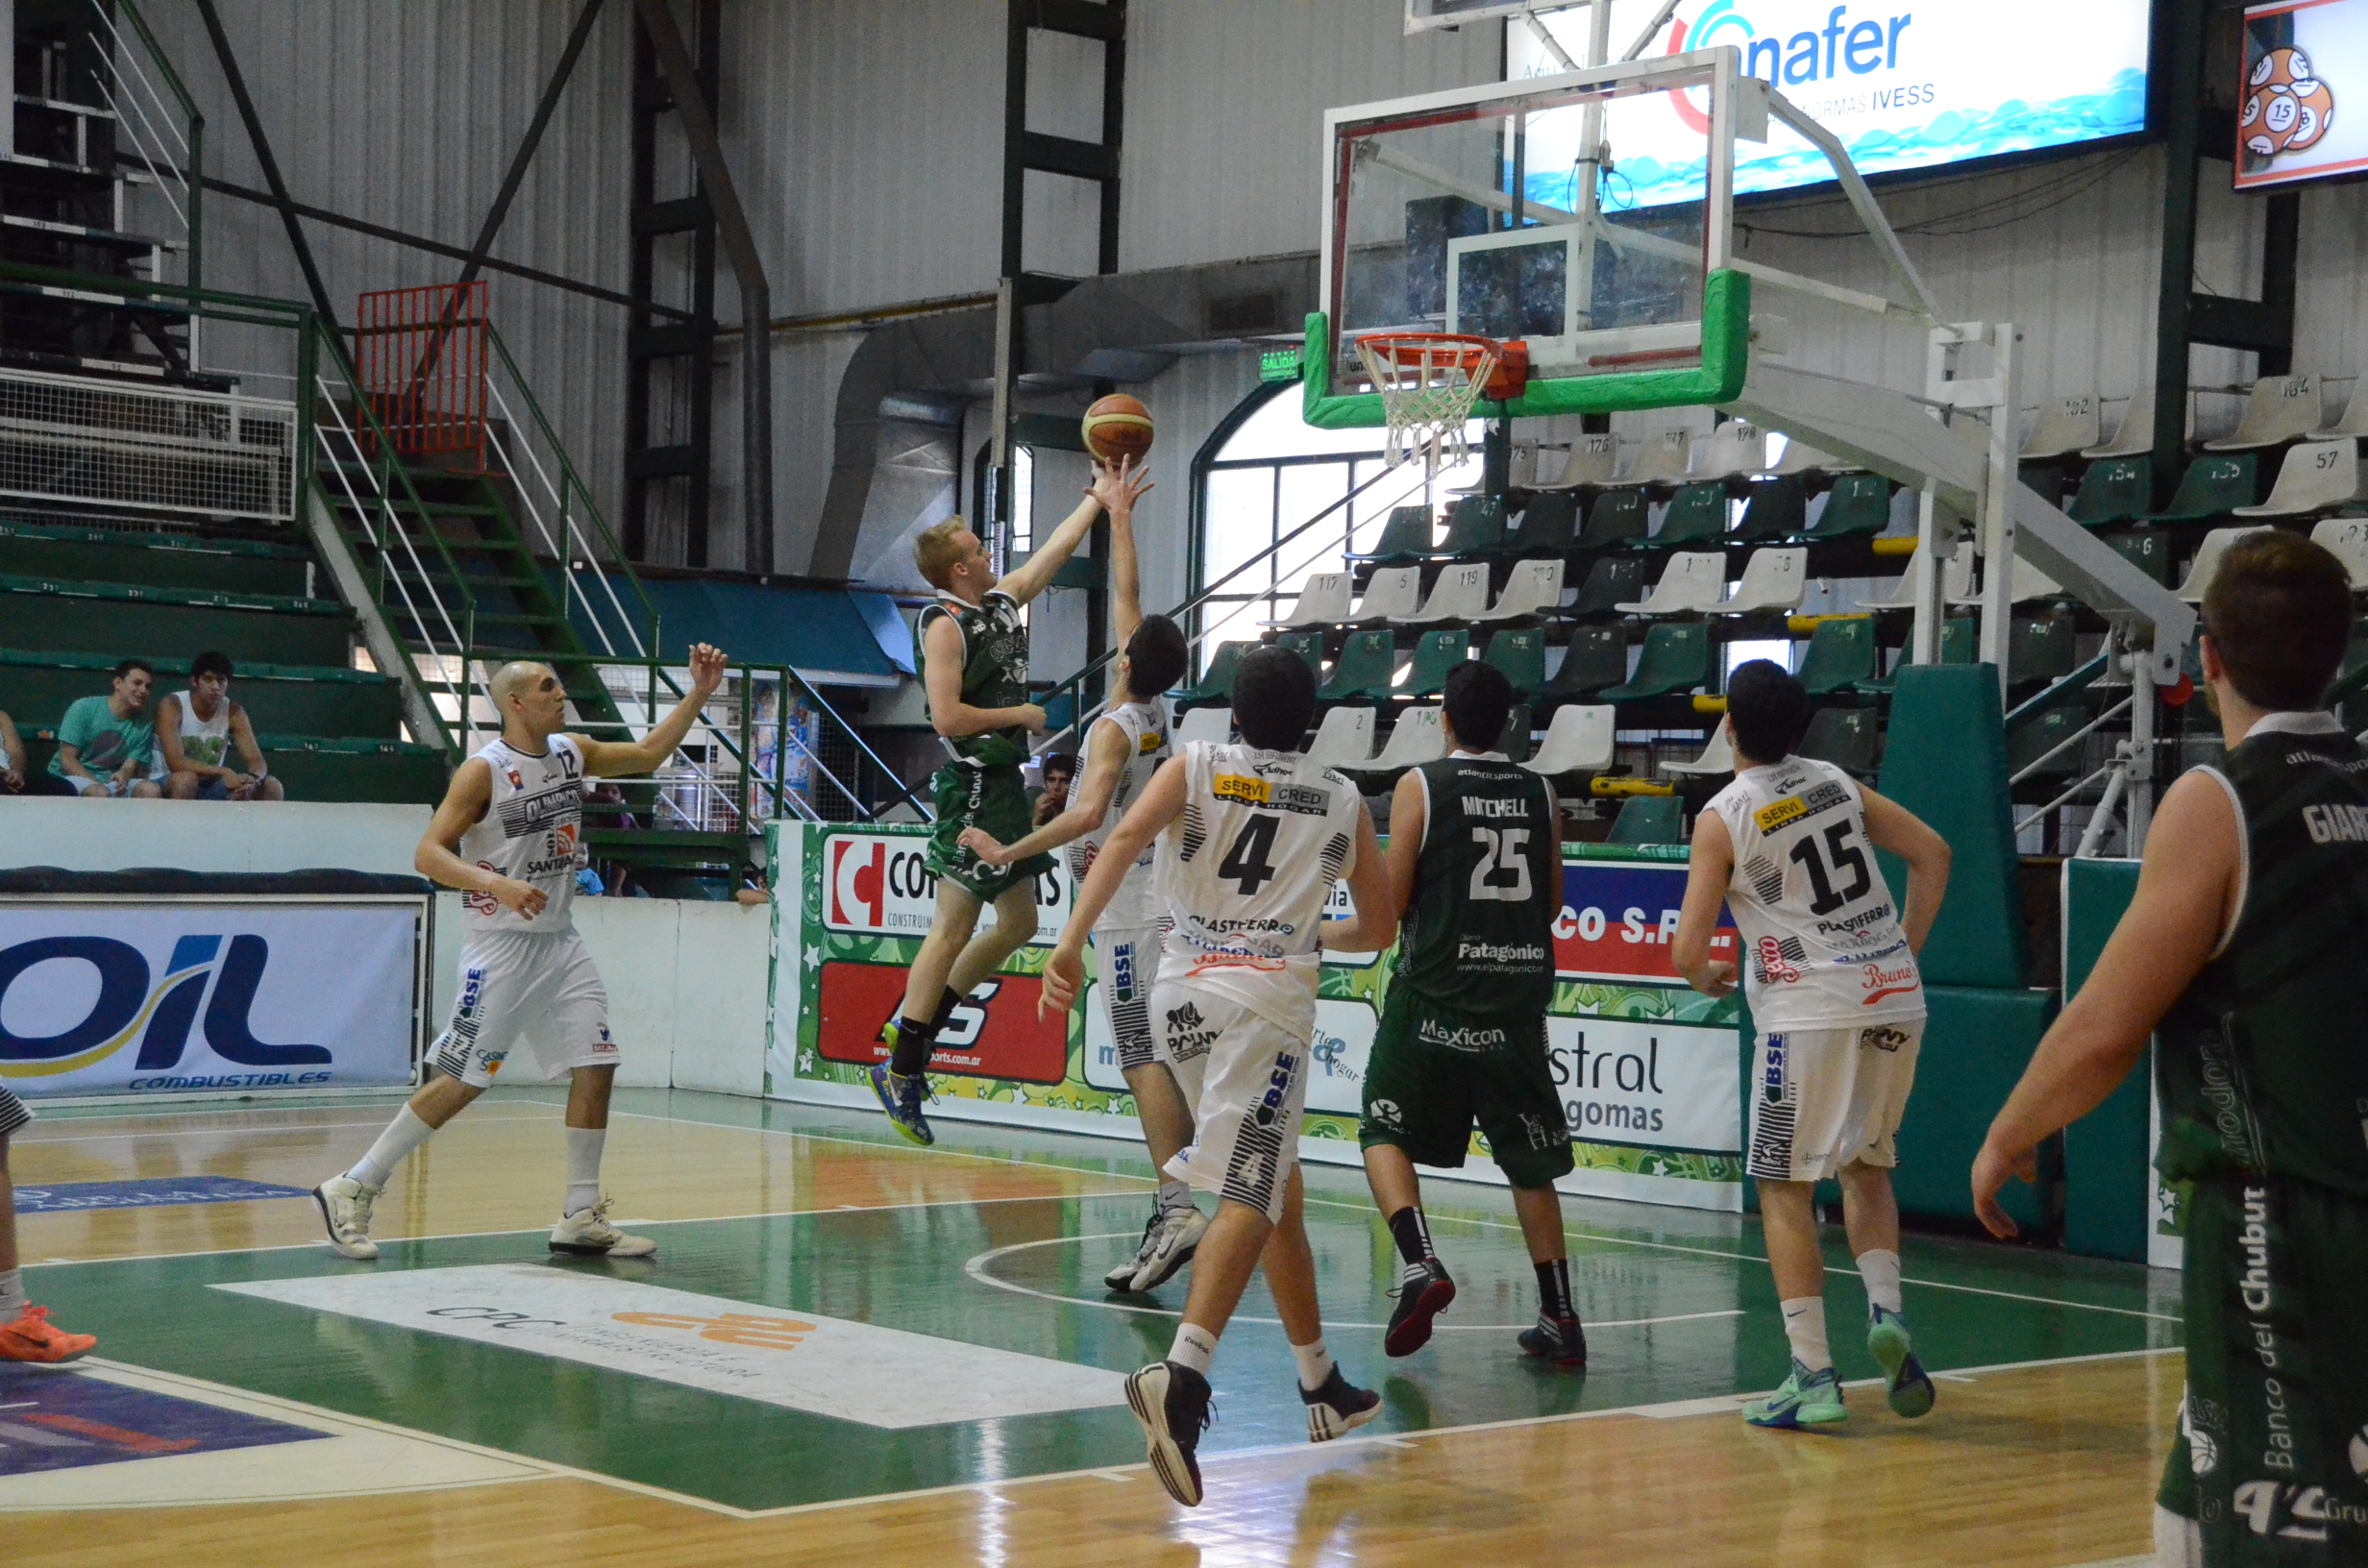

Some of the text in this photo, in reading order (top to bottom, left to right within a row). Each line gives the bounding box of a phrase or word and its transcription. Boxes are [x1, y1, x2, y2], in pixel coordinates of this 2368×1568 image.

[1738, 5, 1912, 86] nafer
[1872, 83, 1935, 111] IVESS
[2274, 104, 2292, 119] 15
[1262, 356, 1295, 371] SALIDA
[2316, 452, 2338, 470] 57
[556, 749, 580, 779] 12
[1218, 795, 1322, 816] LINEA HOGAR
[1221, 779, 1321, 806] SERVI CRED
[1461, 796, 1529, 818] MITCHELL
[1762, 784, 1841, 823] SERVI CRED
[1766, 796, 1850, 834] LINEA HOGAR
[1219, 814, 1280, 895] 4
[1469, 827, 1533, 902] 25
[1789, 819, 1872, 916] 15
[1115, 943, 1132, 989] BSE
[1325, 1047, 1360, 1084] hogar
[1765, 1033, 1785, 1086] BSE
[129, 1071, 333, 1090] COMBUSTIBLES
[1568, 1096, 1664, 1134] gomas
[2238, 1186, 2294, 1469] Banco del Chubut
